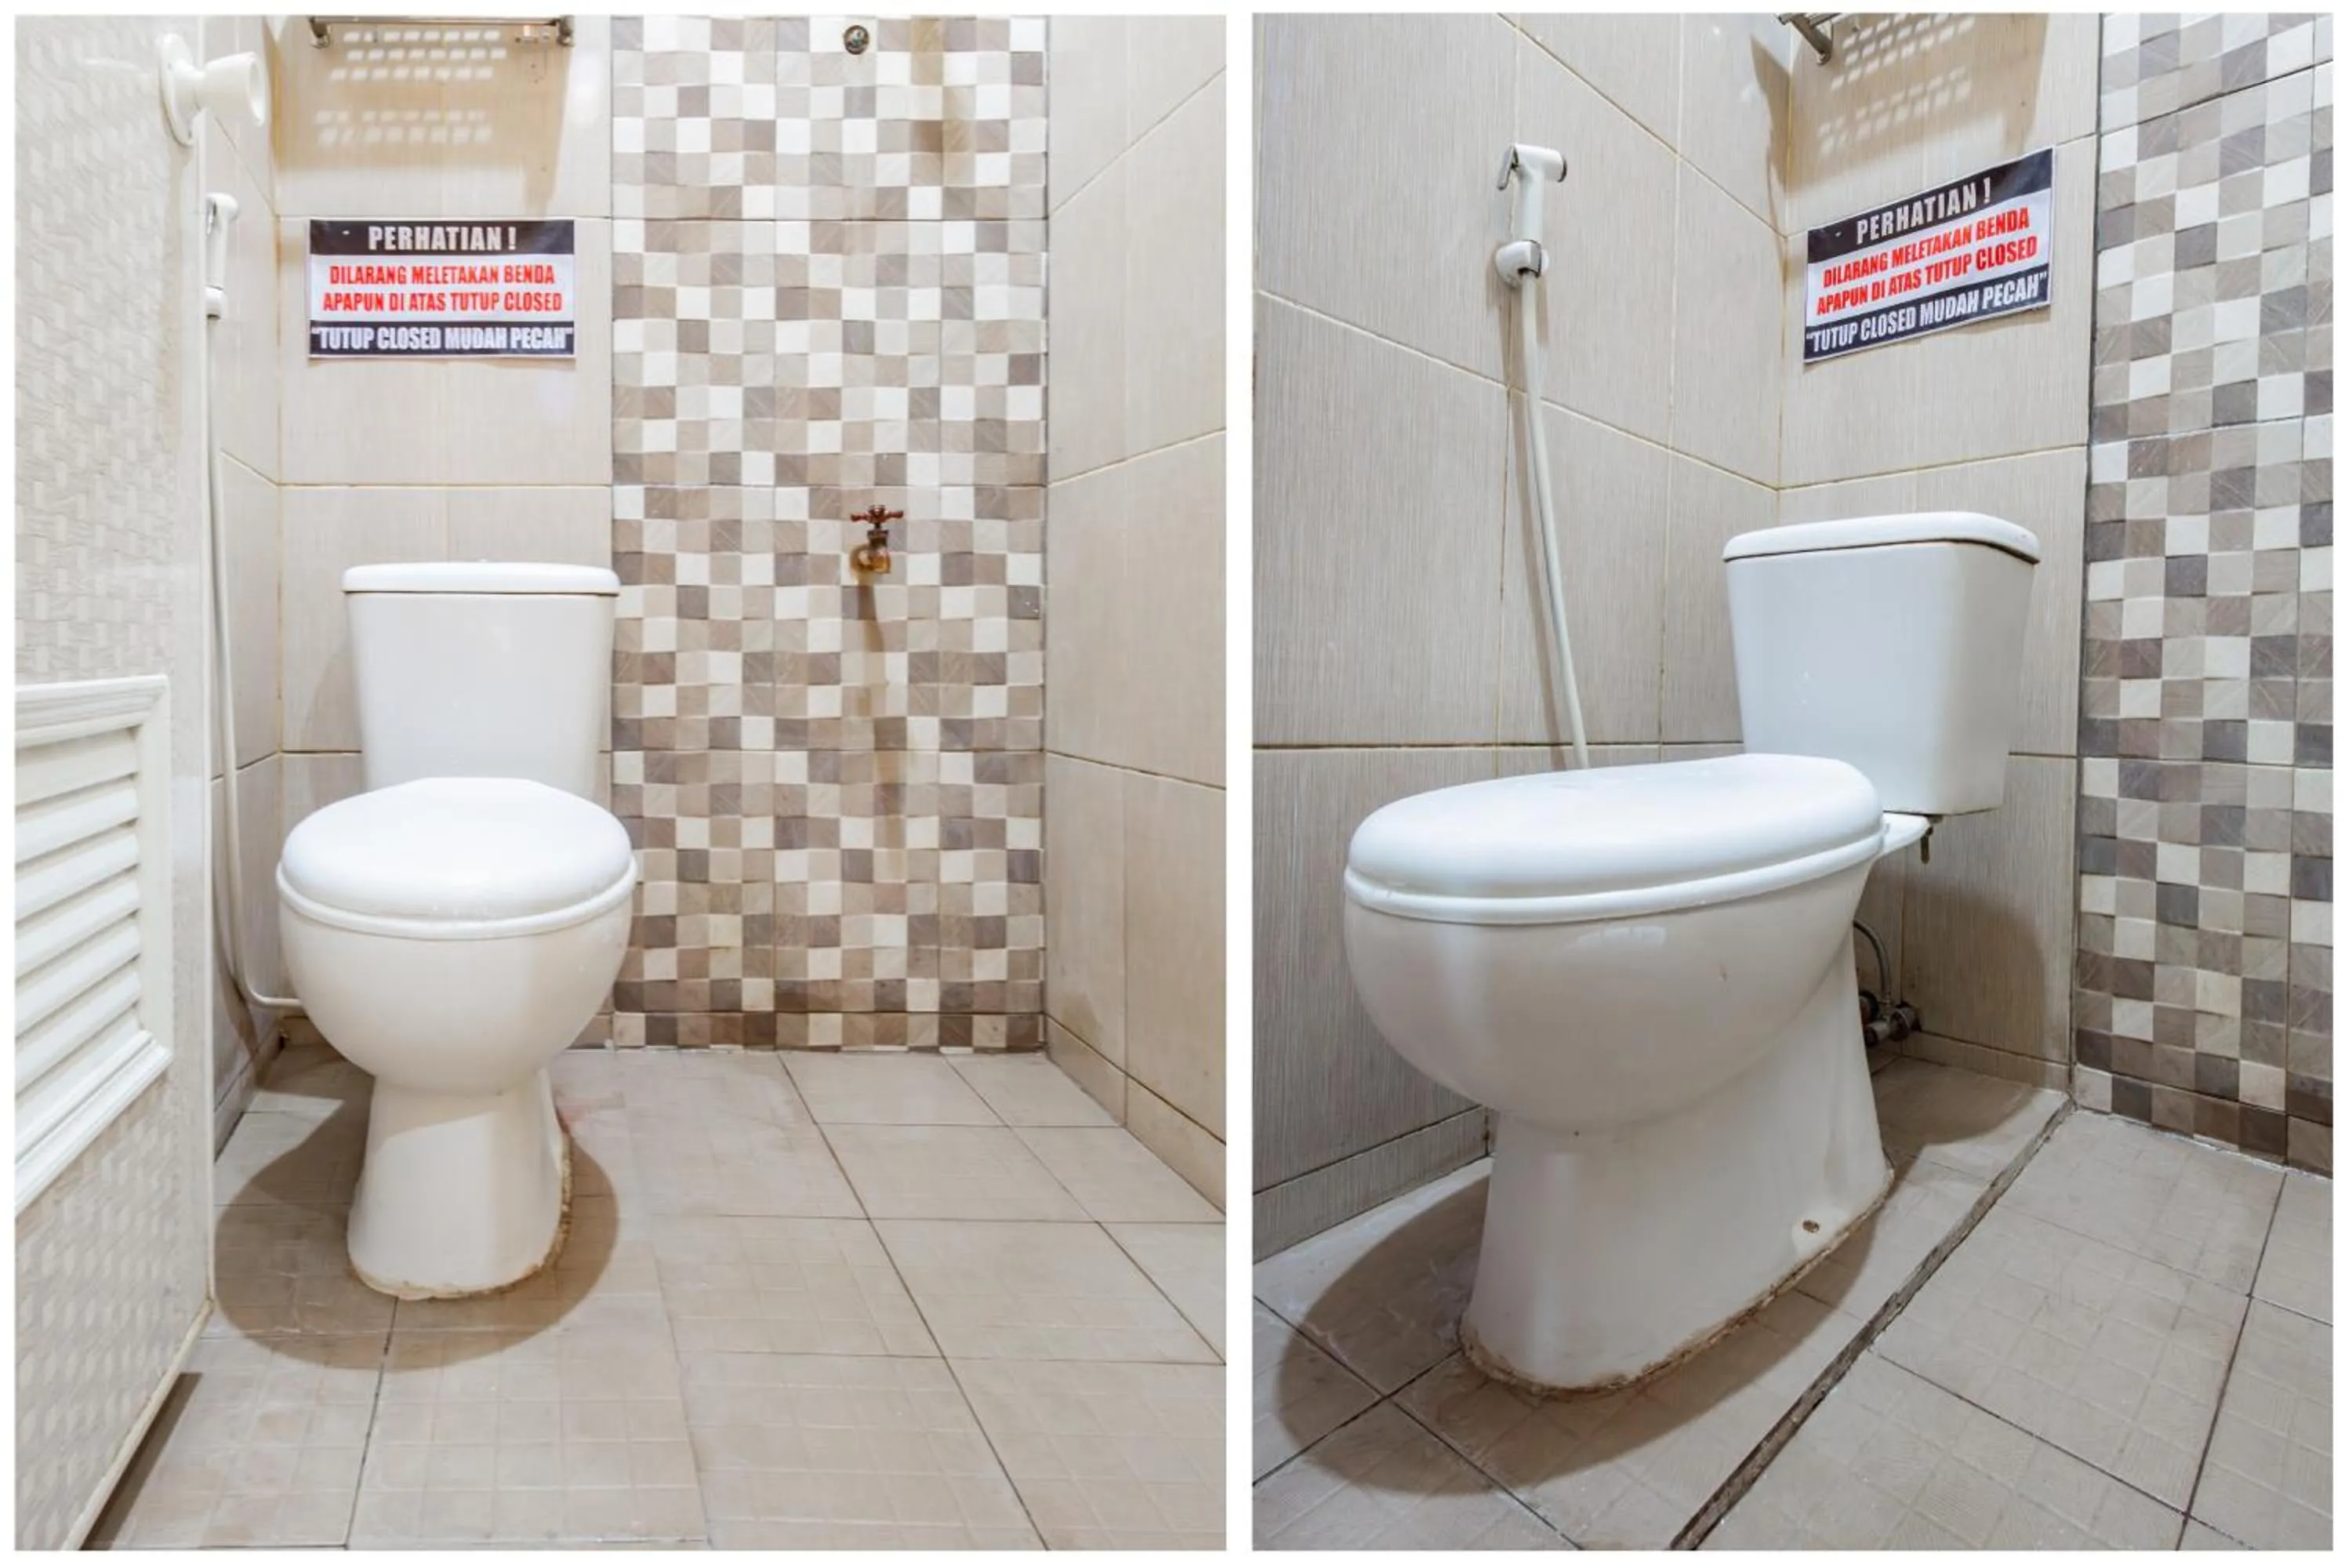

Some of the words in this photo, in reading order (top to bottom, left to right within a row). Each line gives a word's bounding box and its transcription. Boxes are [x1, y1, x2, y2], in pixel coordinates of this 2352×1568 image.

[1857, 182, 1977, 245] PERHATIAN
[1983, 176, 1991, 204] !
[368, 226, 502, 250] PERHATIAN
[508, 227, 517, 250] !
[1824, 256, 1889, 289] DILARANG
[1891, 224, 1973, 268] MELETAKAN
[1976, 206, 2029, 241] BENDA
[328, 265, 407, 285] DILARANG
[412, 265, 499, 285] MELETAKAN
[504, 264, 555, 285] BENDA
[1817, 283, 1868, 315] APAPUN
[1871, 279, 1886, 299] DI
[1888, 270, 1922, 296] ATAS
[1925, 254, 1972, 285] TUTUP
[1976, 236, 2038, 270] CLOSED
[323, 292, 384, 311] APAPUN
[389, 292, 405, 311] DI
[408, 292, 446, 311] ATAS
[450, 292, 499, 311] TUTUP
[504, 292, 562, 311] CLOSED
[1860, 307, 1916, 341] CLOSED
[1919, 290, 1980, 327] MUDAH
[377, 327, 441, 350] CLOSED
[445, 327, 507, 350] MUDAH
